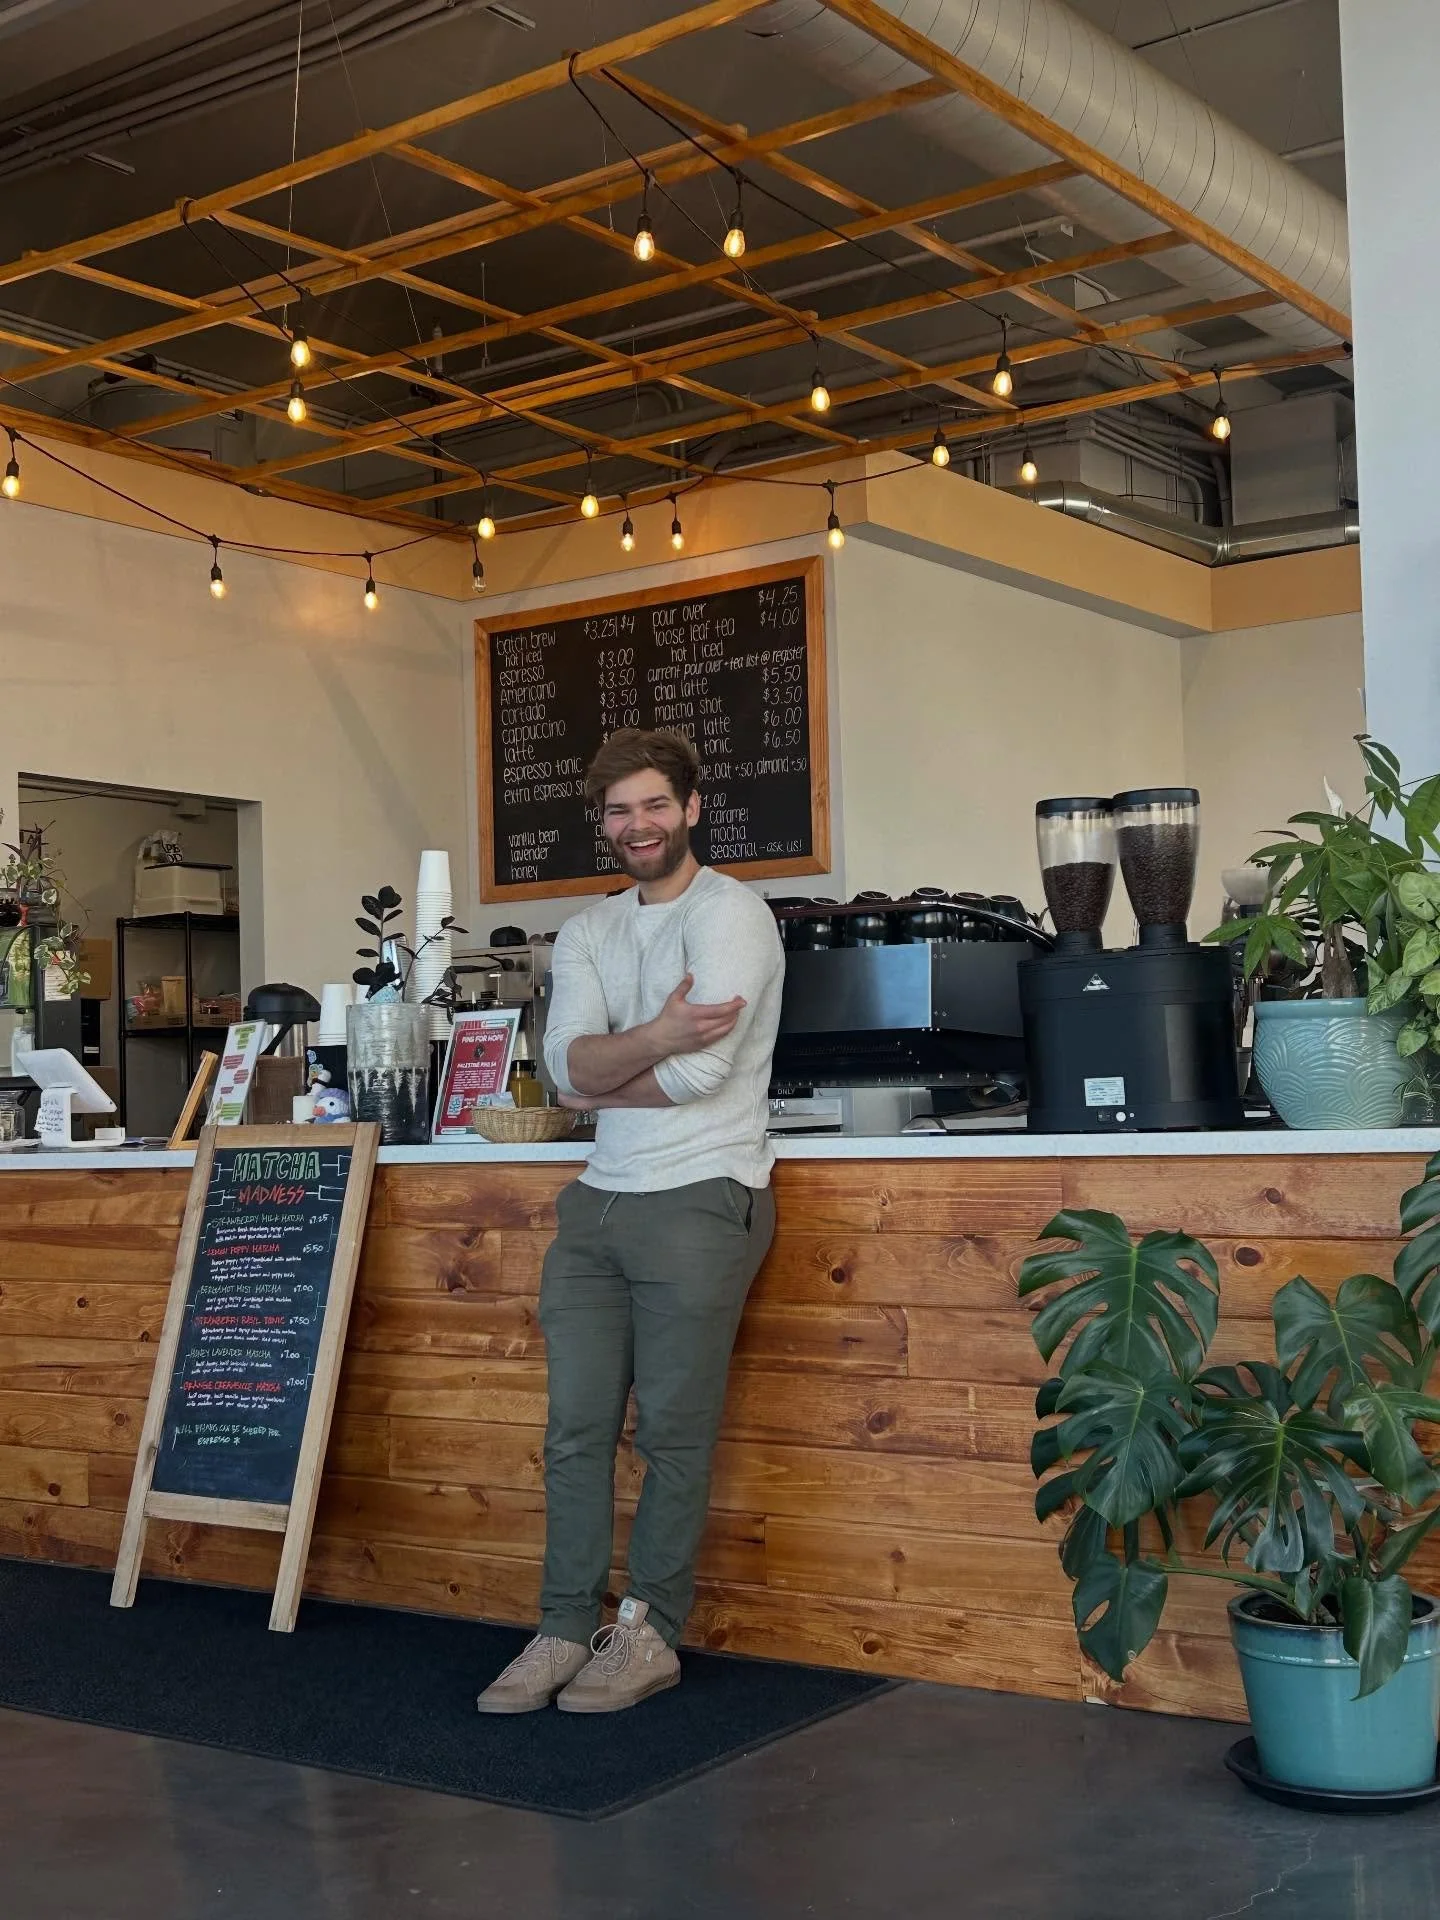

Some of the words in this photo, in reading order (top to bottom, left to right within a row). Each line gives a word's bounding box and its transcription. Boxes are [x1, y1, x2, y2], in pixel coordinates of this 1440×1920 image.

[758, 585, 799, 607] $4.25
[620, 614, 635, 634] $4
[652, 607, 677, 635] pour
[682, 602, 707, 622] over
[760, 607, 800, 629] $4.00
[496, 632, 528, 656] batch
[531, 629, 556, 649] brew
[655, 626, 685, 647] loose
[690, 620, 711, 642] leaf
[714, 617, 735, 638] tea
[505, 652, 519, 668] hot
[525, 649, 542, 664] iced
[597, 647, 634, 669] $3.00
[670, 645, 688, 663] hot
[701, 640, 724, 659] iced
[647, 664, 681, 683] current
[683, 661, 704, 681] pour
[704, 658, 722, 675] over
[729, 655, 744, 671] tea
[745, 652, 760, 668] list
[771, 645, 807, 668] register
[762, 664, 801, 685] $5.50
[499, 664, 545, 687] espresso
[598, 667, 635, 689] $3.50
[500, 681, 556, 706] Americano
[600, 688, 637, 708] $3.50
[654, 683, 676, 702] chai
[680, 677, 709, 698] latte
[762, 685, 802, 705] $3.50
[501, 702, 546, 726] cortado
[601, 708, 640, 729] $4.00
[654, 701, 695, 723] matcha
[699, 696, 723, 715] shot
[762, 706, 802, 727] $6.00
[502, 720, 566, 745] cappuccino
[703, 716, 731, 736] latte
[704, 737, 733, 756] tonic
[763, 728, 801, 749] $6.50
[504, 743, 536, 763] latte
[503, 761, 552, 785] espresso
[555, 757, 583, 776] tonic
[504, 787, 531, 805] extra
[533, 781, 573, 801] espresso
[575, 777, 588, 796] sh
[709, 807, 749, 825] caramel
[508, 831, 536, 849] vanilla
[538, 828, 560, 844] bean
[710, 824, 747, 843] mocha
[510, 845, 550, 863] lavender
[710, 841, 758, 860] seasonal
[786, 839, 803, 853] us!
[511, 864, 539, 881] honey
[778, 1087, 796, 1095] ONLY
[232, 1151, 321, 1182] MATCHA
[238, 1183, 305, 1205] MADNESS
